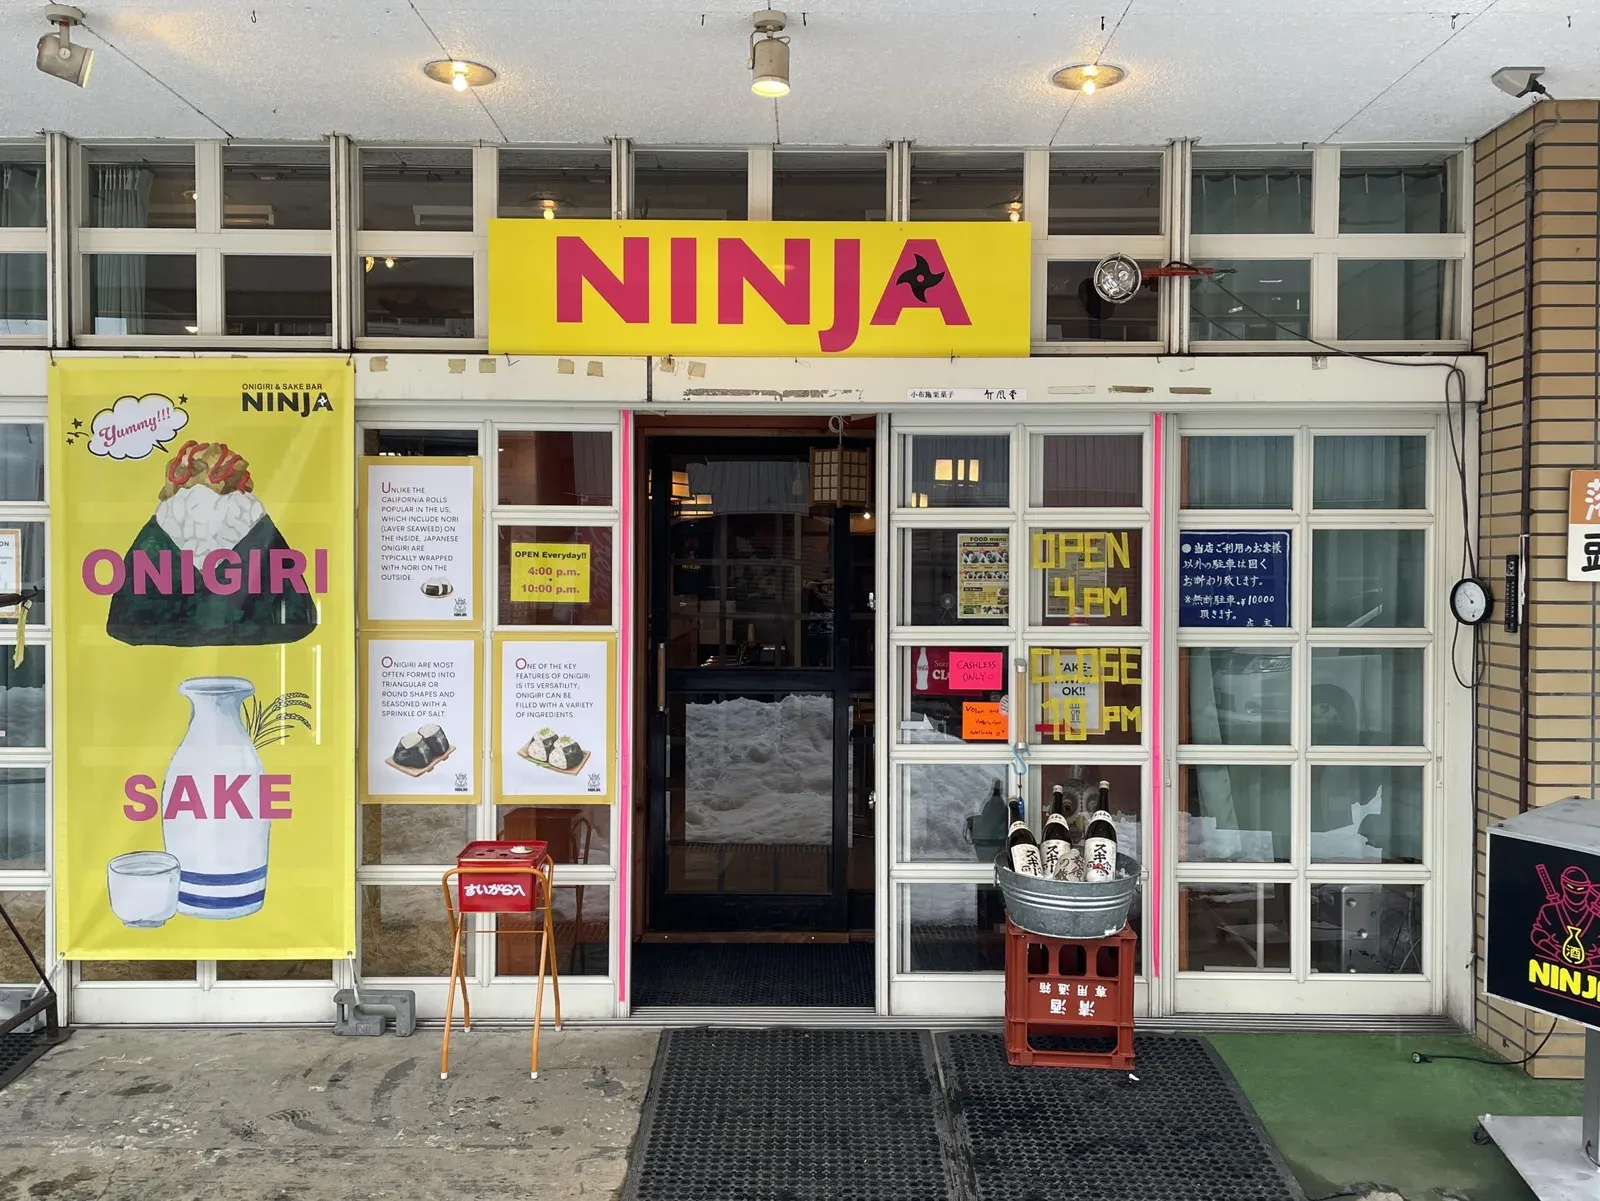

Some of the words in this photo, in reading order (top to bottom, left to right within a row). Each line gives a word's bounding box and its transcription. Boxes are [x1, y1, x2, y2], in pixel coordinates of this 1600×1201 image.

[556, 235, 972, 353] NINJA
[242, 392, 334, 417] NINJA
[98, 408, 171, 448] Yummy!!!
[381, 482, 410, 494] UNLIKE
[542, 551, 586, 560] Everyday!!
[1033, 532, 1130, 568] OPEN
[1183, 558, 1266, 570] 以外の駐車は固く
[82, 548, 328, 596] ONIGIRI
[528, 567, 552, 575] 4:00
[556, 569, 580, 577] p.m.
[1183, 575, 1263, 587] お断わり致します。
[521, 584, 552, 592] 10:00
[556, 586, 579, 594] p.m.
[1054, 577, 1075, 616] 4
[1084, 587, 1127, 617] PM
[1200, 609, 1236, 620] 頂きます。
[381, 656, 416, 668] ONIGIRI
[515, 658, 536, 670] ONE
[957, 660, 996, 669] CASHLESS
[1031, 648, 1141, 684] CLOSE
[963, 672, 986, 681] ONLY
[1062, 687, 1085, 696] OK!!
[1042, 698, 1087, 740] 10
[1104, 706, 1142, 732] PM
[123, 774, 293, 821] SAKE
[464, 884, 526, 897] すいがら入
[1566, 945, 1581, 960] 酒
[1529, 958, 1600, 1002] NINJ
[1050, 999, 1094, 1017] 清酒
